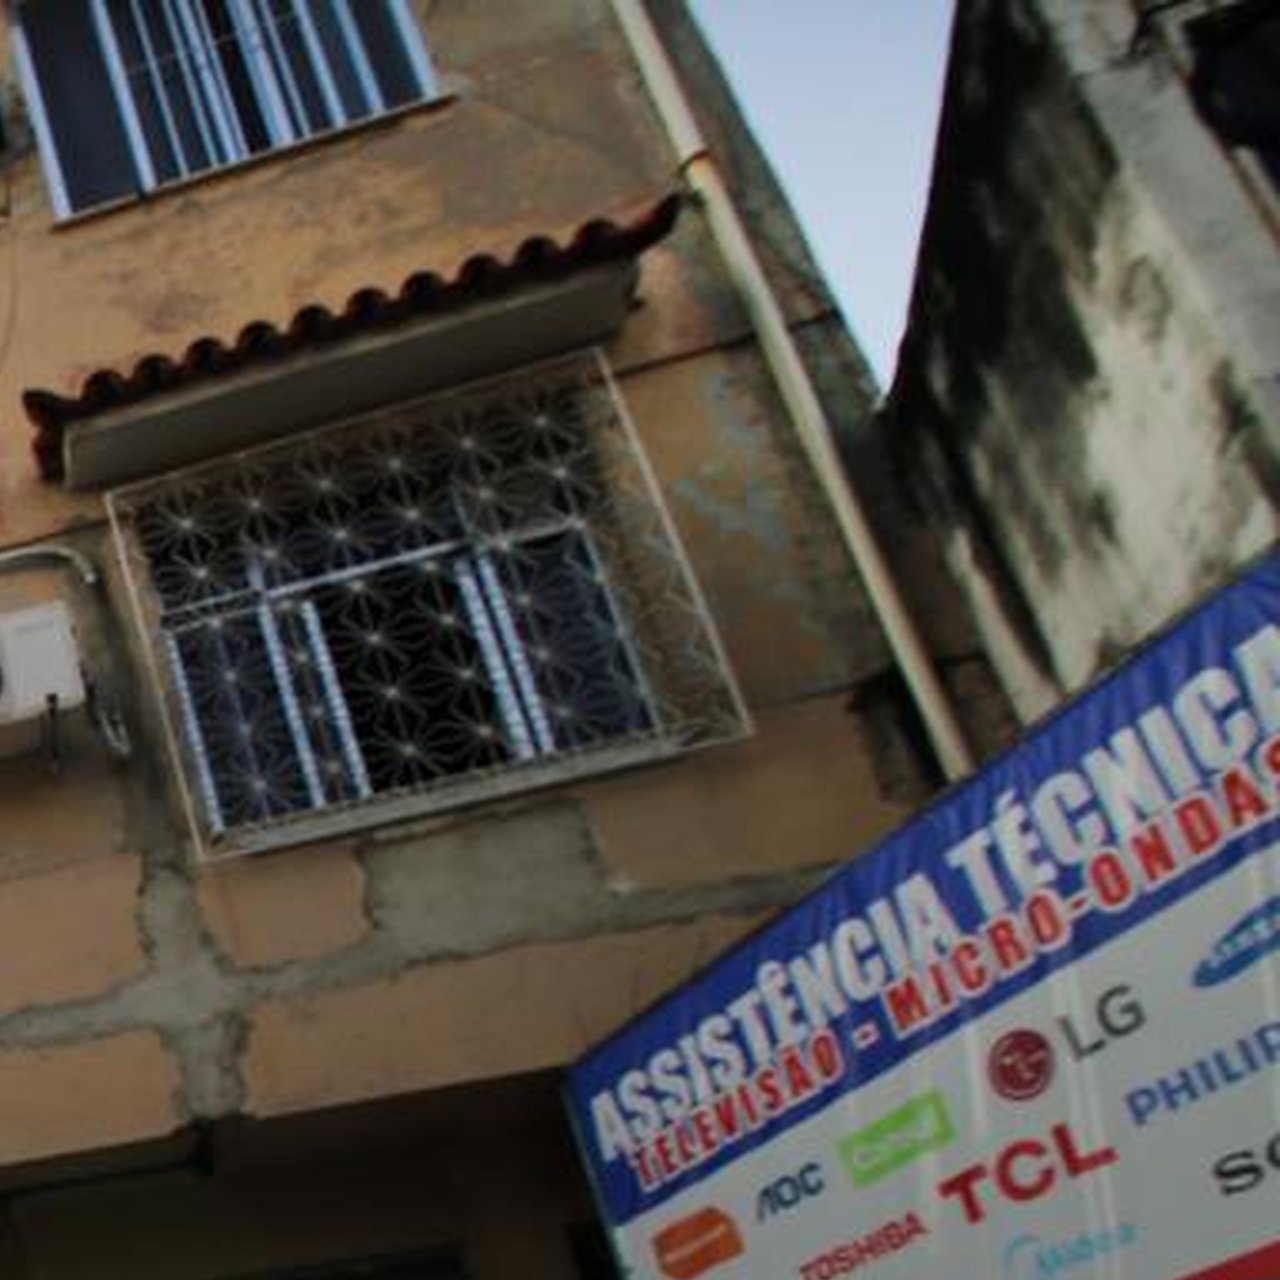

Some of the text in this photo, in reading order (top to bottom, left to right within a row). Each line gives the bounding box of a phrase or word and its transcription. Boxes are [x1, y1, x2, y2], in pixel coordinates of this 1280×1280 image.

[592, 623, 1280, 1162] ASSISTÊNCIA TÉCNICA
[1056, 985, 1146, 1060] LG
[757, 1162, 824, 1221] AOC
[939, 1124, 1119, 1225] TCL
